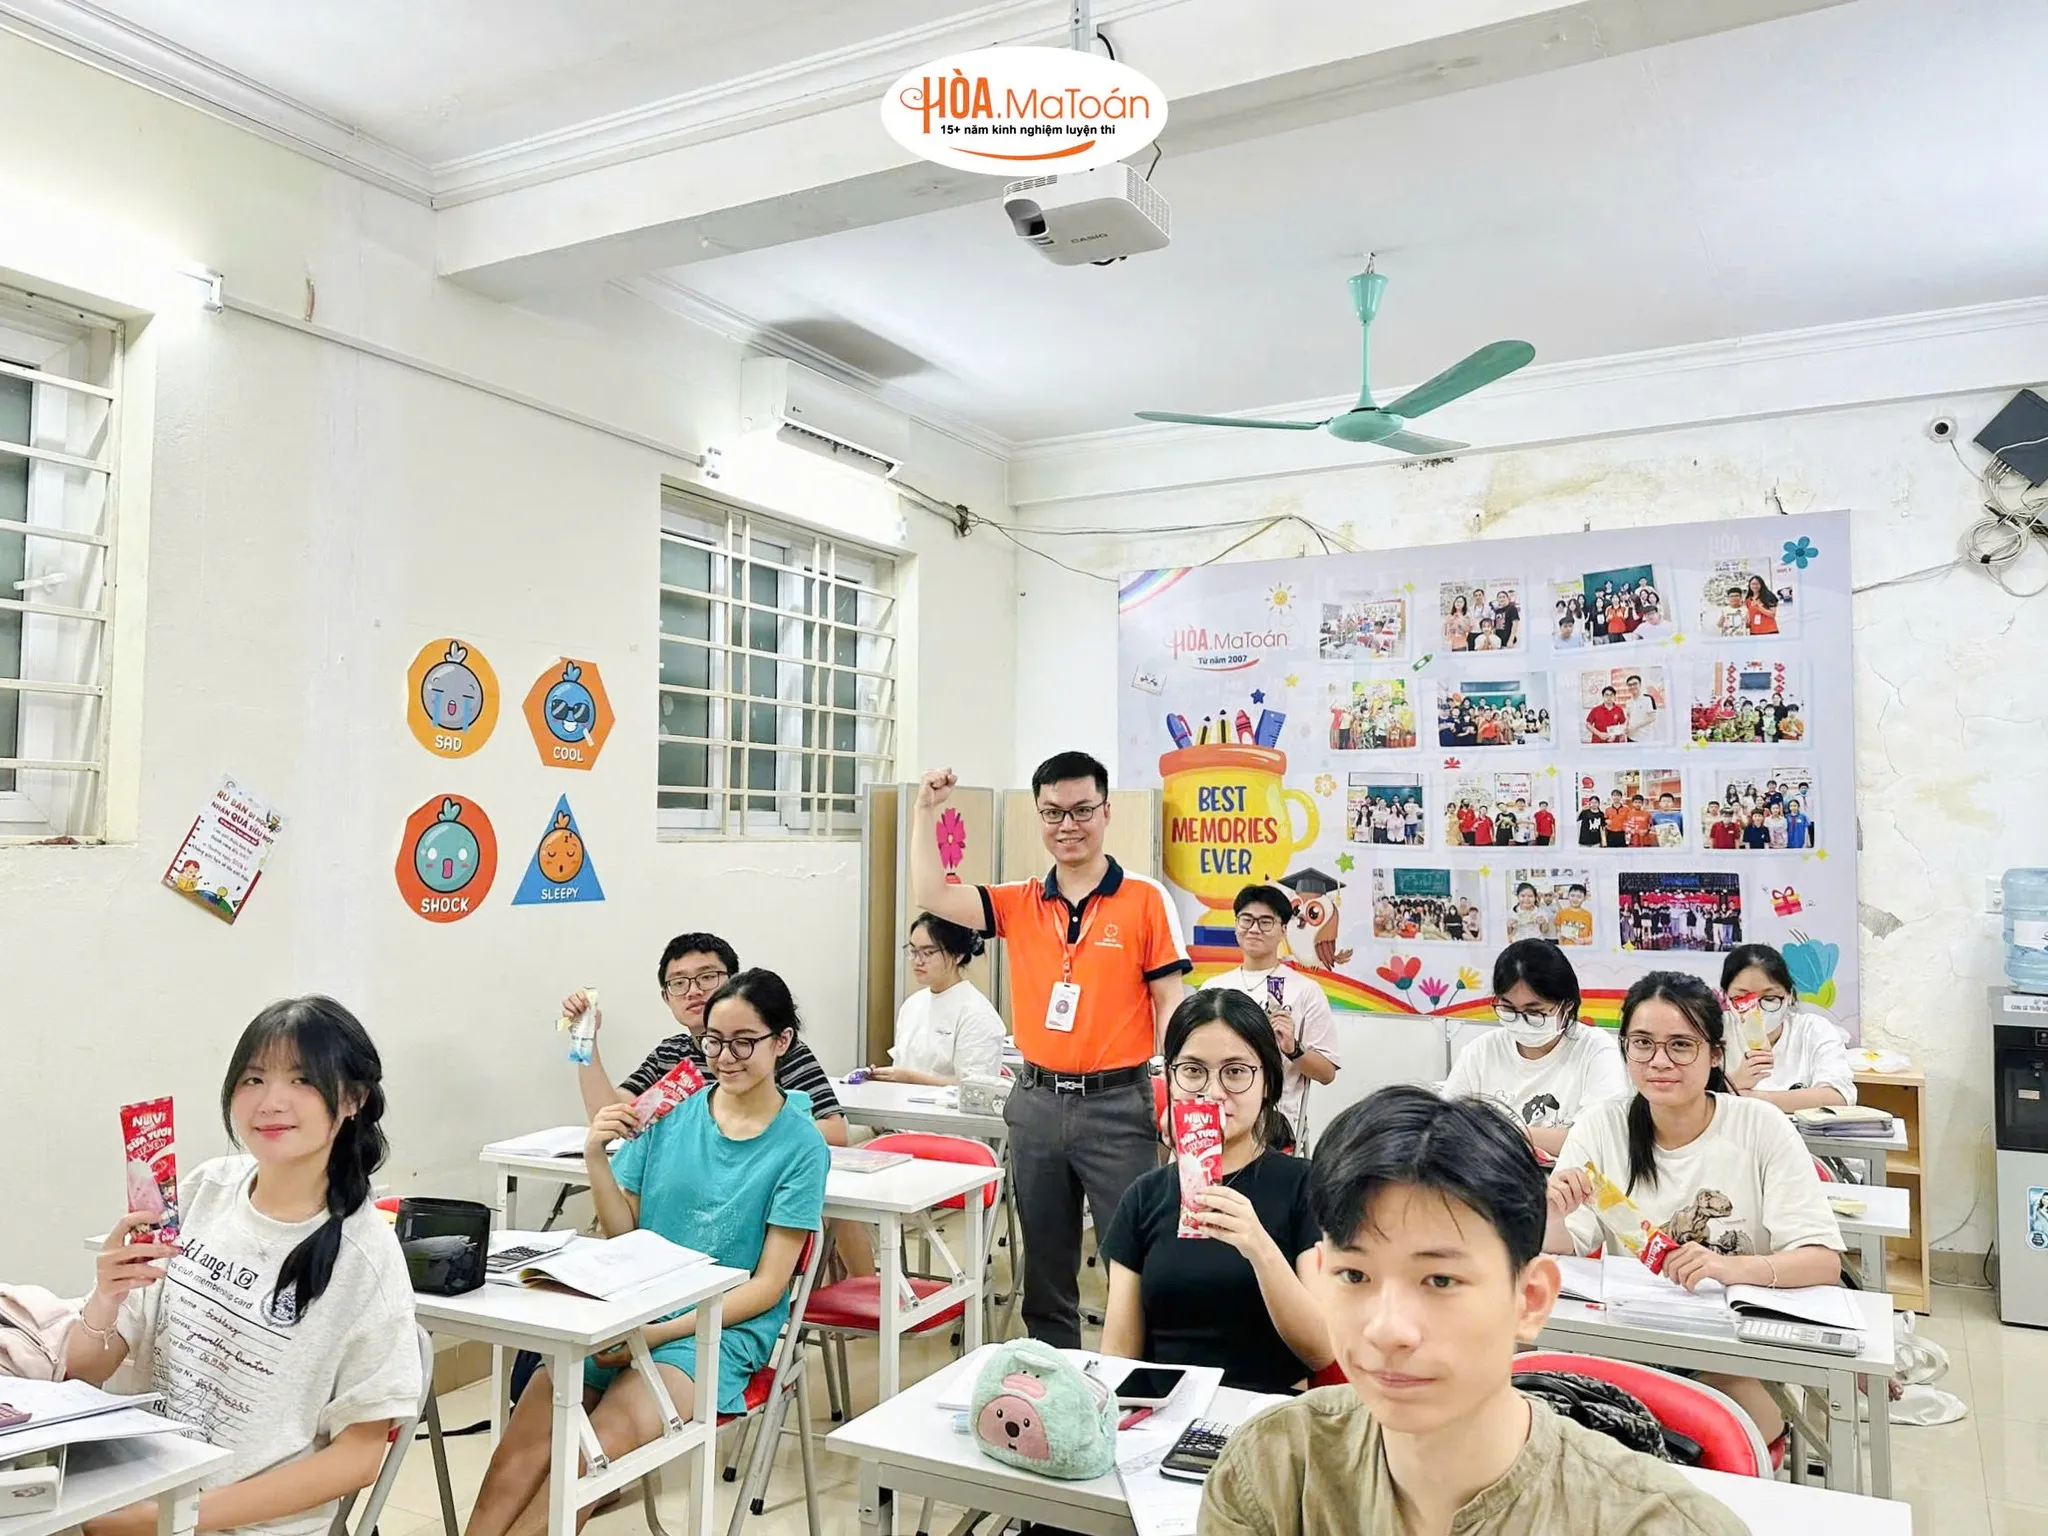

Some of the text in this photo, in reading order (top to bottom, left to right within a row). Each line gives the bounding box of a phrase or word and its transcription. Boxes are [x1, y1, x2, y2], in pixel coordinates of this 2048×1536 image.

[1209, 656, 1226, 664] năm
[1228, 655, 1248, 663] 2007
[434, 734, 462, 752] SAD
[552, 746, 584, 762] COOL
[1198, 785, 1247, 813] BEST
[1171, 817, 1278, 844] MEMORIES
[1200, 848, 1252, 876] EVER
[541, 887, 580, 901] SLEEPY
[420, 897, 469, 914] SHOCK
[233, 1296, 254, 1310] card
